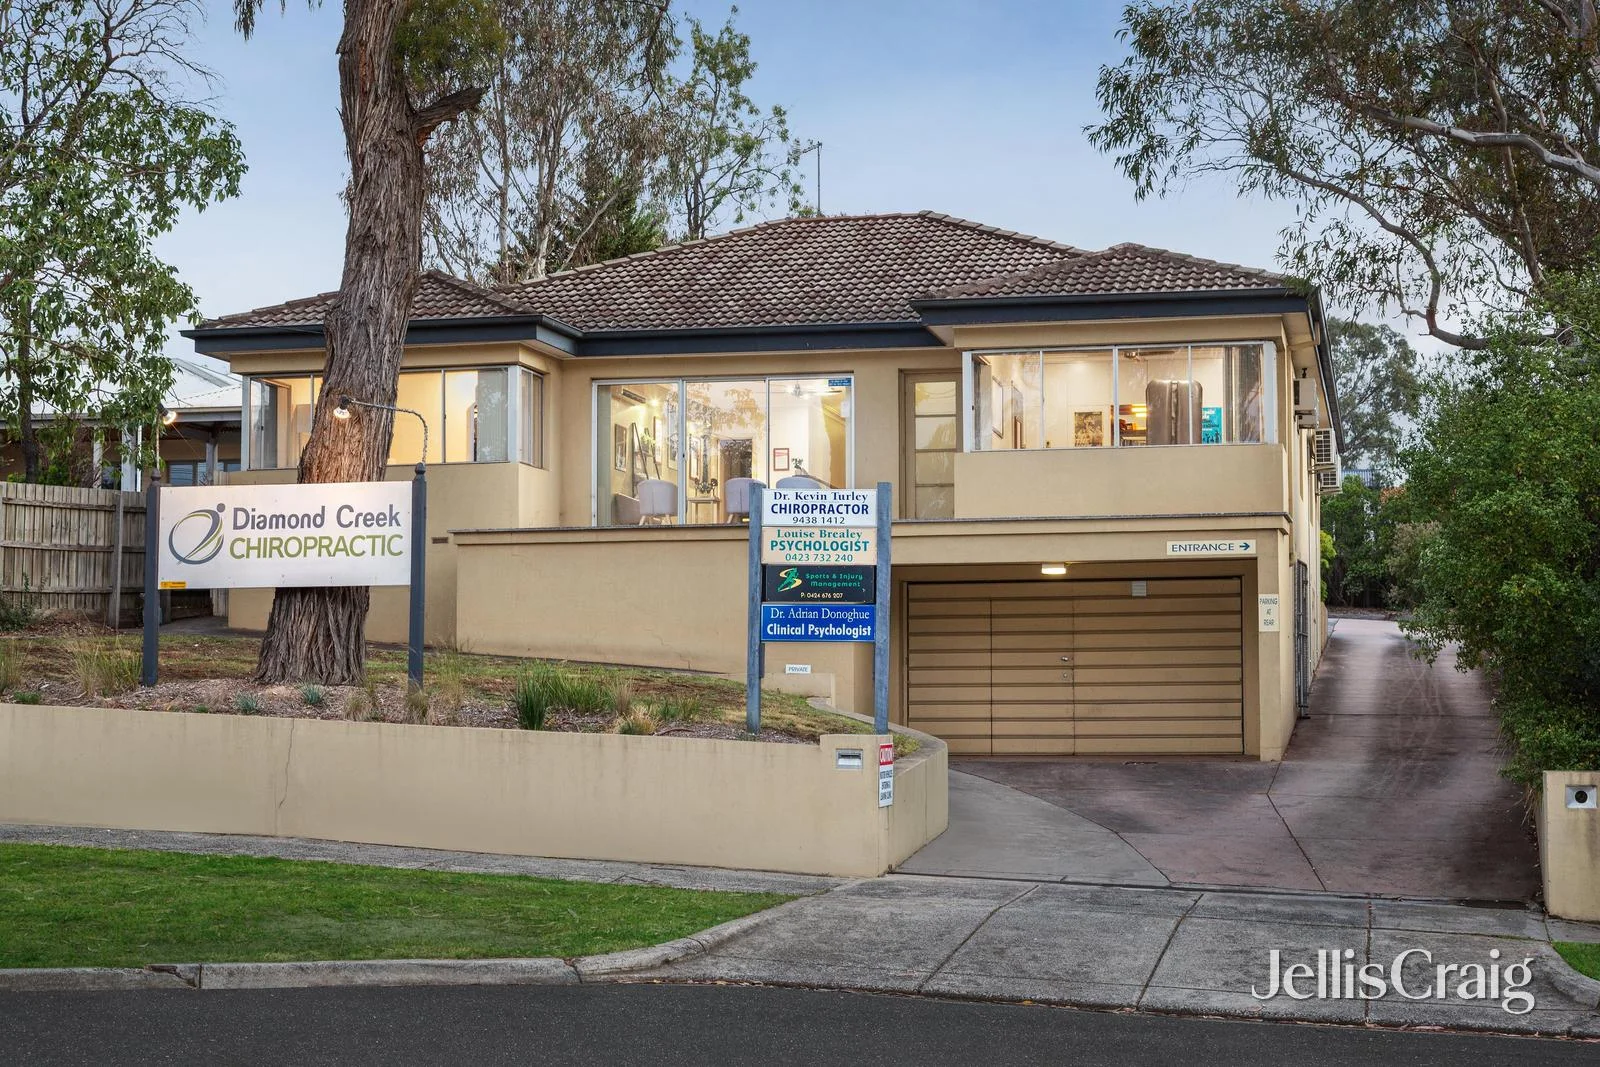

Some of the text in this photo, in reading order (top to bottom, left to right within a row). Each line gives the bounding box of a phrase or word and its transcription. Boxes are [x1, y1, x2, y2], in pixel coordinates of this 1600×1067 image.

[774, 492, 868, 503] Dr. Kevin Turley
[771, 504, 869, 514] CHIROPRACTOR
[232, 504, 401, 530] Diamond Creek
[777, 530, 862, 540] Louise Brealey
[229, 534, 404, 560] CHIROPRACTIC
[770, 541, 869, 551] PSYCHOLOGIST
[1172, 543, 1234, 552] ENTRANCE
[785, 554, 853, 562] 0423 732 240
[770, 608, 870, 622] Dr. Adrian Donoghue
[766, 624, 872, 638] Clinical Psychologist
